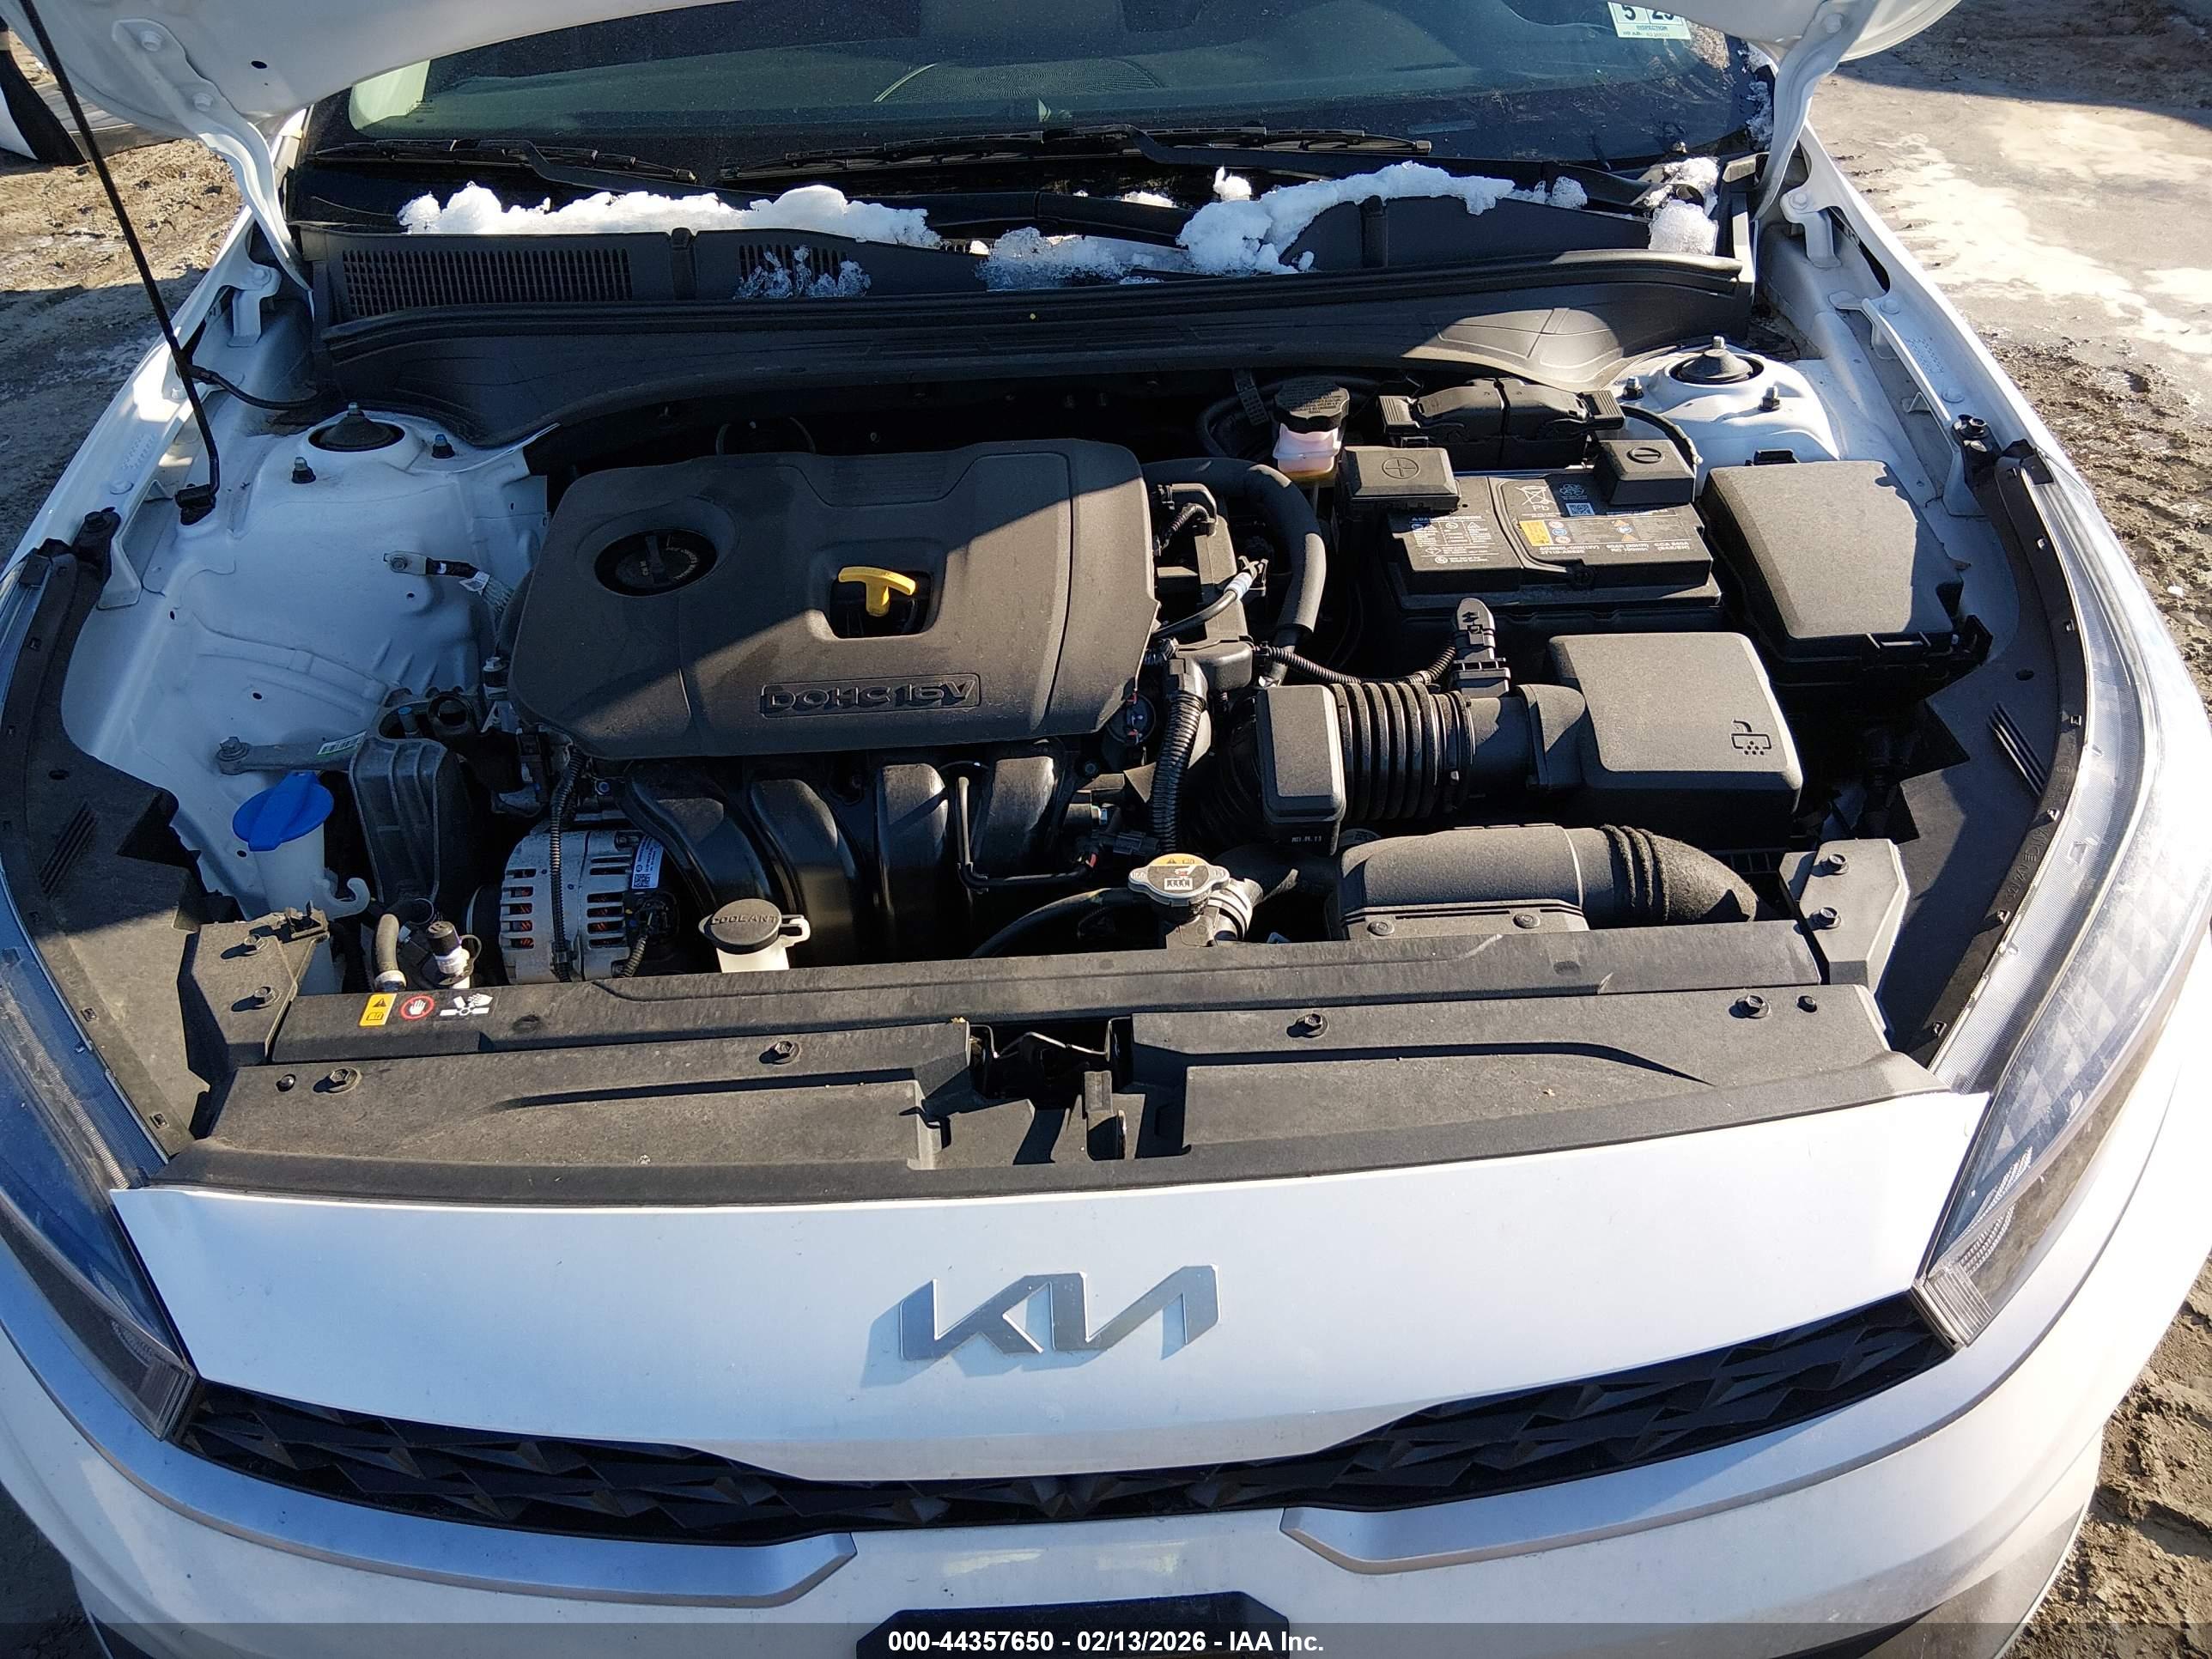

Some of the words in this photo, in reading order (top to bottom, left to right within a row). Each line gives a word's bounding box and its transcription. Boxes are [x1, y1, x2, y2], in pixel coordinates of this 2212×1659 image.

[1621, 4, 1636, 21] 5
[769, 686, 891, 708] DOHC
[896, 679, 976, 706] 16V
[710, 914, 778, 926] COOLANT
